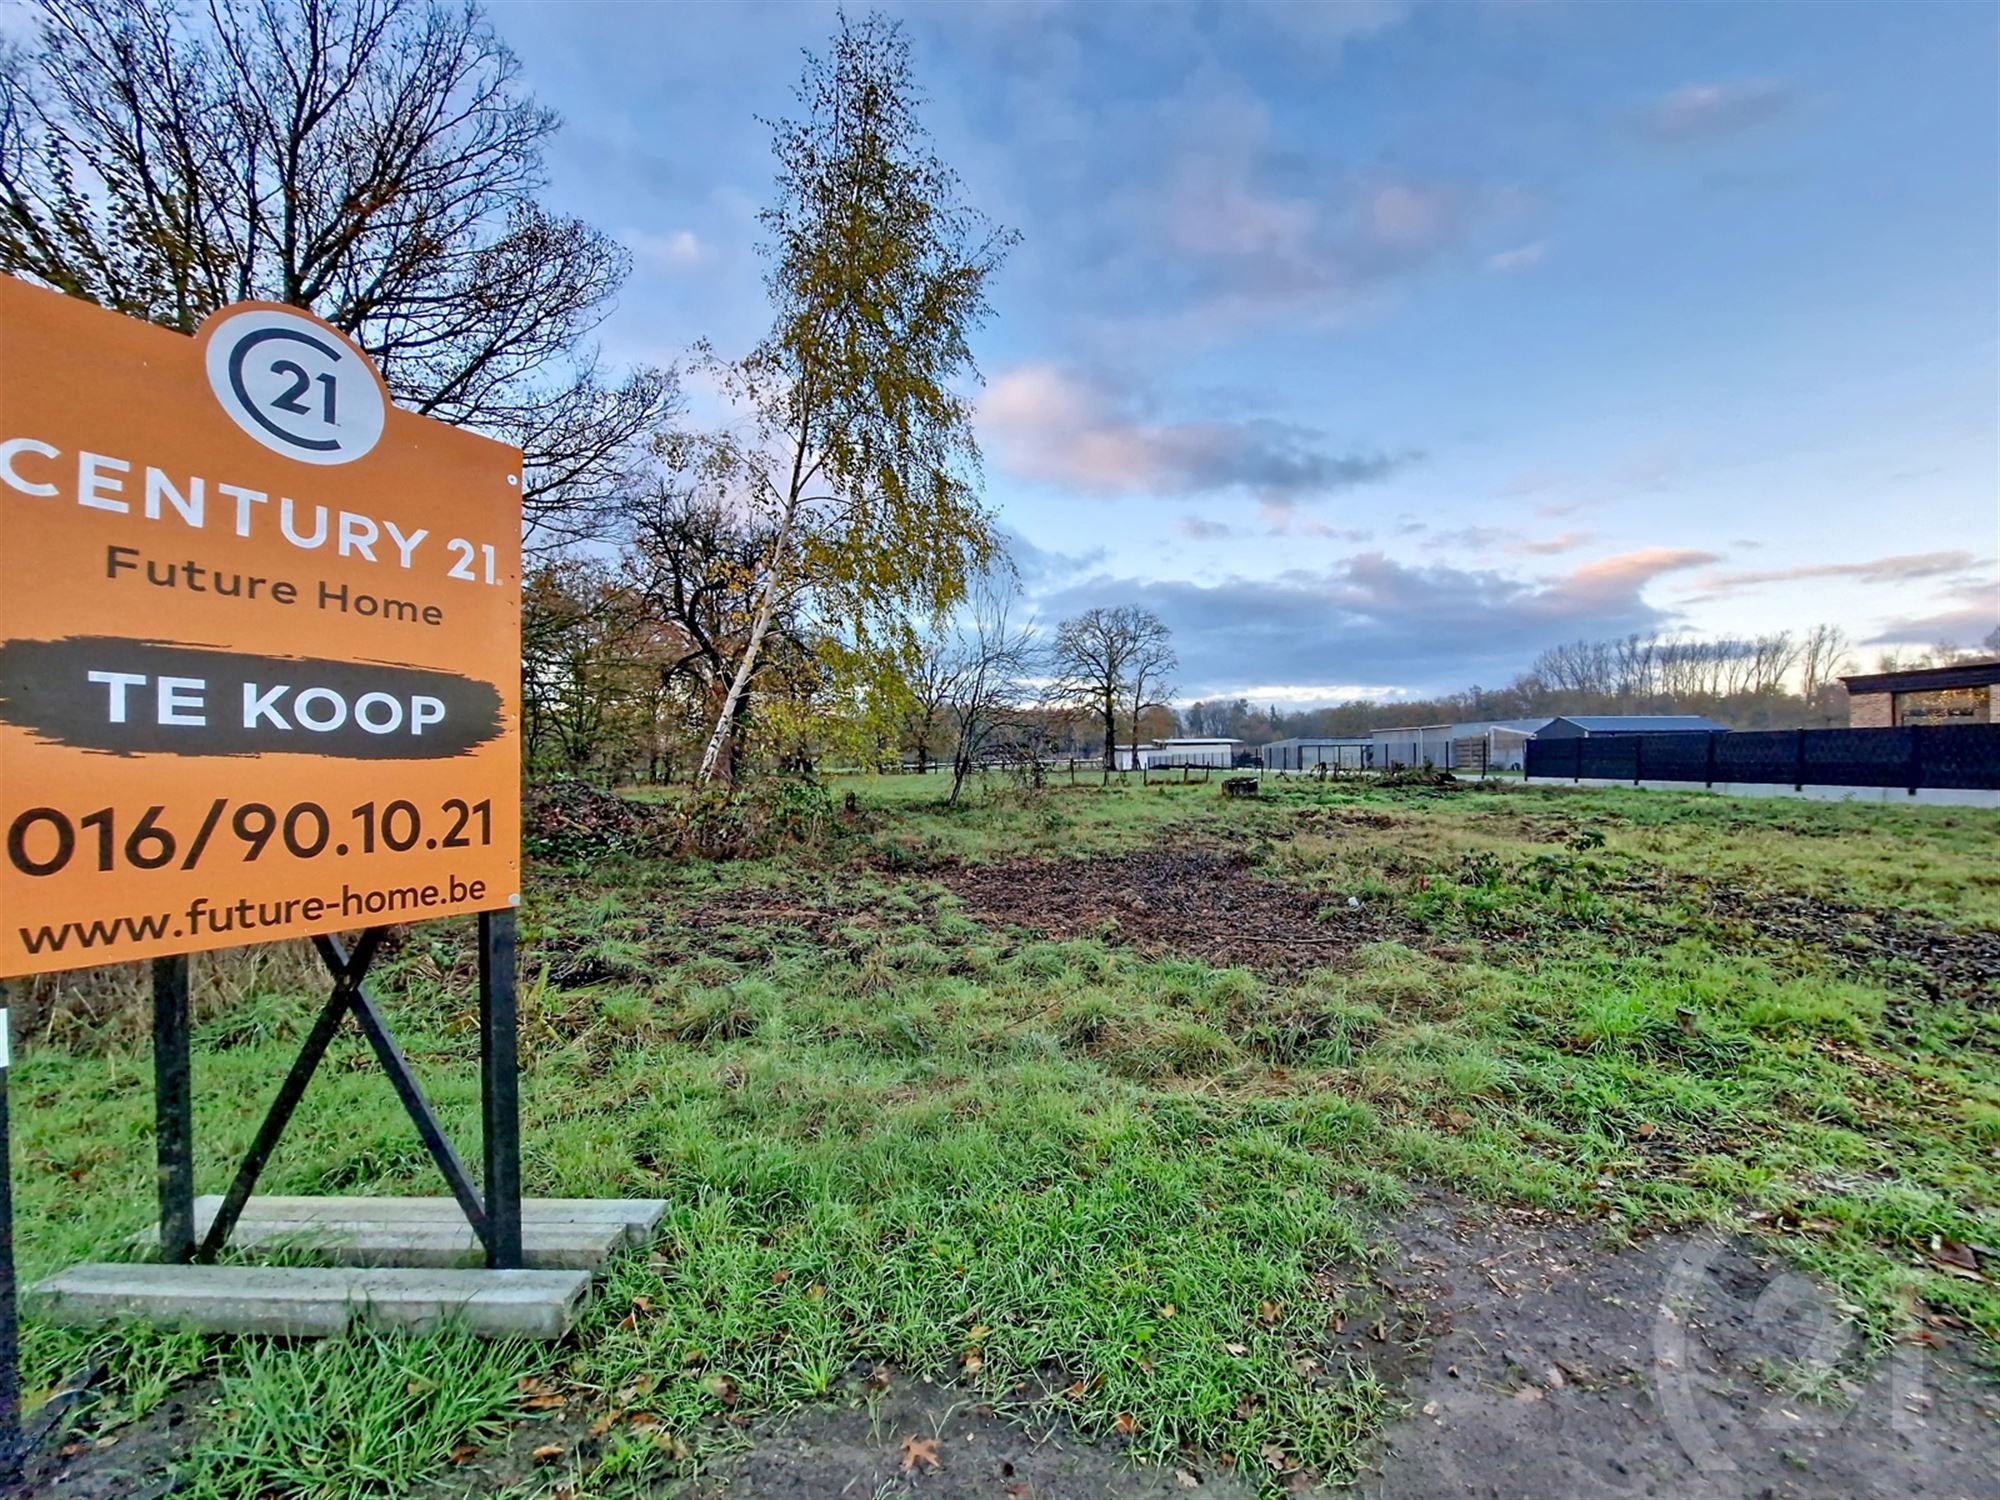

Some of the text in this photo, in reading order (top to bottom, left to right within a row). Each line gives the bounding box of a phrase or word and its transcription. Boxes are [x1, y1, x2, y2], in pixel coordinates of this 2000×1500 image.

[0, 438, 496, 585] CENTURY 21
[106, 545, 444, 626] Future Home
[88, 671, 446, 735] TE KOOP
[7, 798, 492, 877] 016/90.10.21
[19, 875, 486, 954] www.future-home.be
